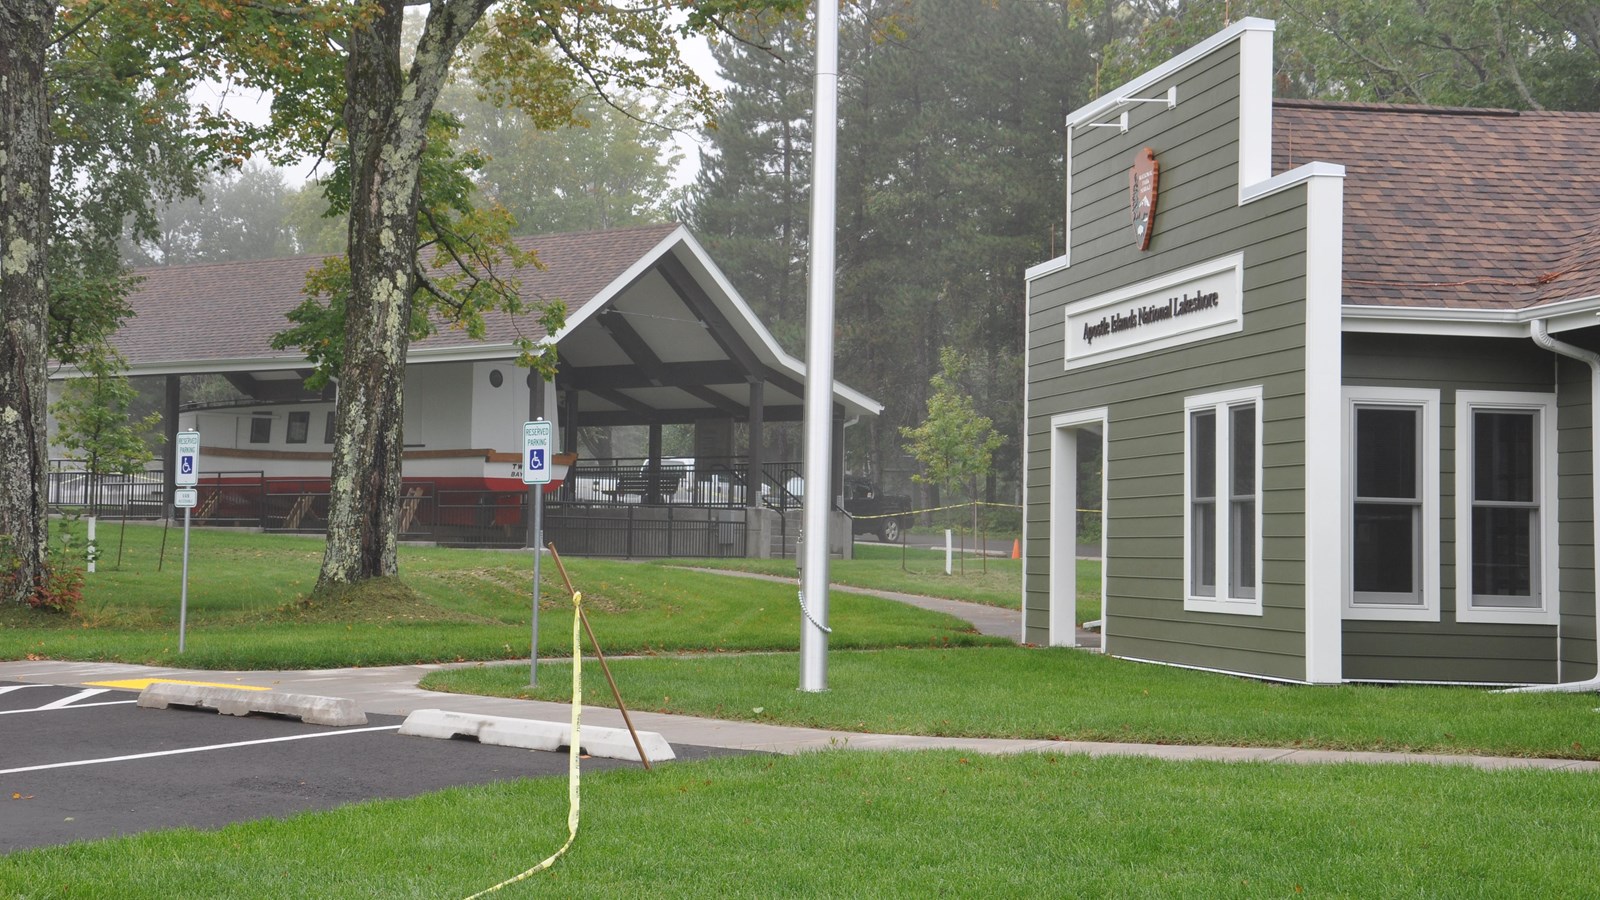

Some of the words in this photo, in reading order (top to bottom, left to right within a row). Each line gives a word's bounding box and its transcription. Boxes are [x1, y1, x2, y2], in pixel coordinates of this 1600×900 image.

[1083, 317, 1110, 344] Apostle
[1110, 309, 1137, 333] Islands
[1137, 298, 1172, 326] National
[1173, 290, 1219, 316] Lakeshore
[526, 427, 549, 436] RESERVED
[527, 438, 547, 446] PARKING
